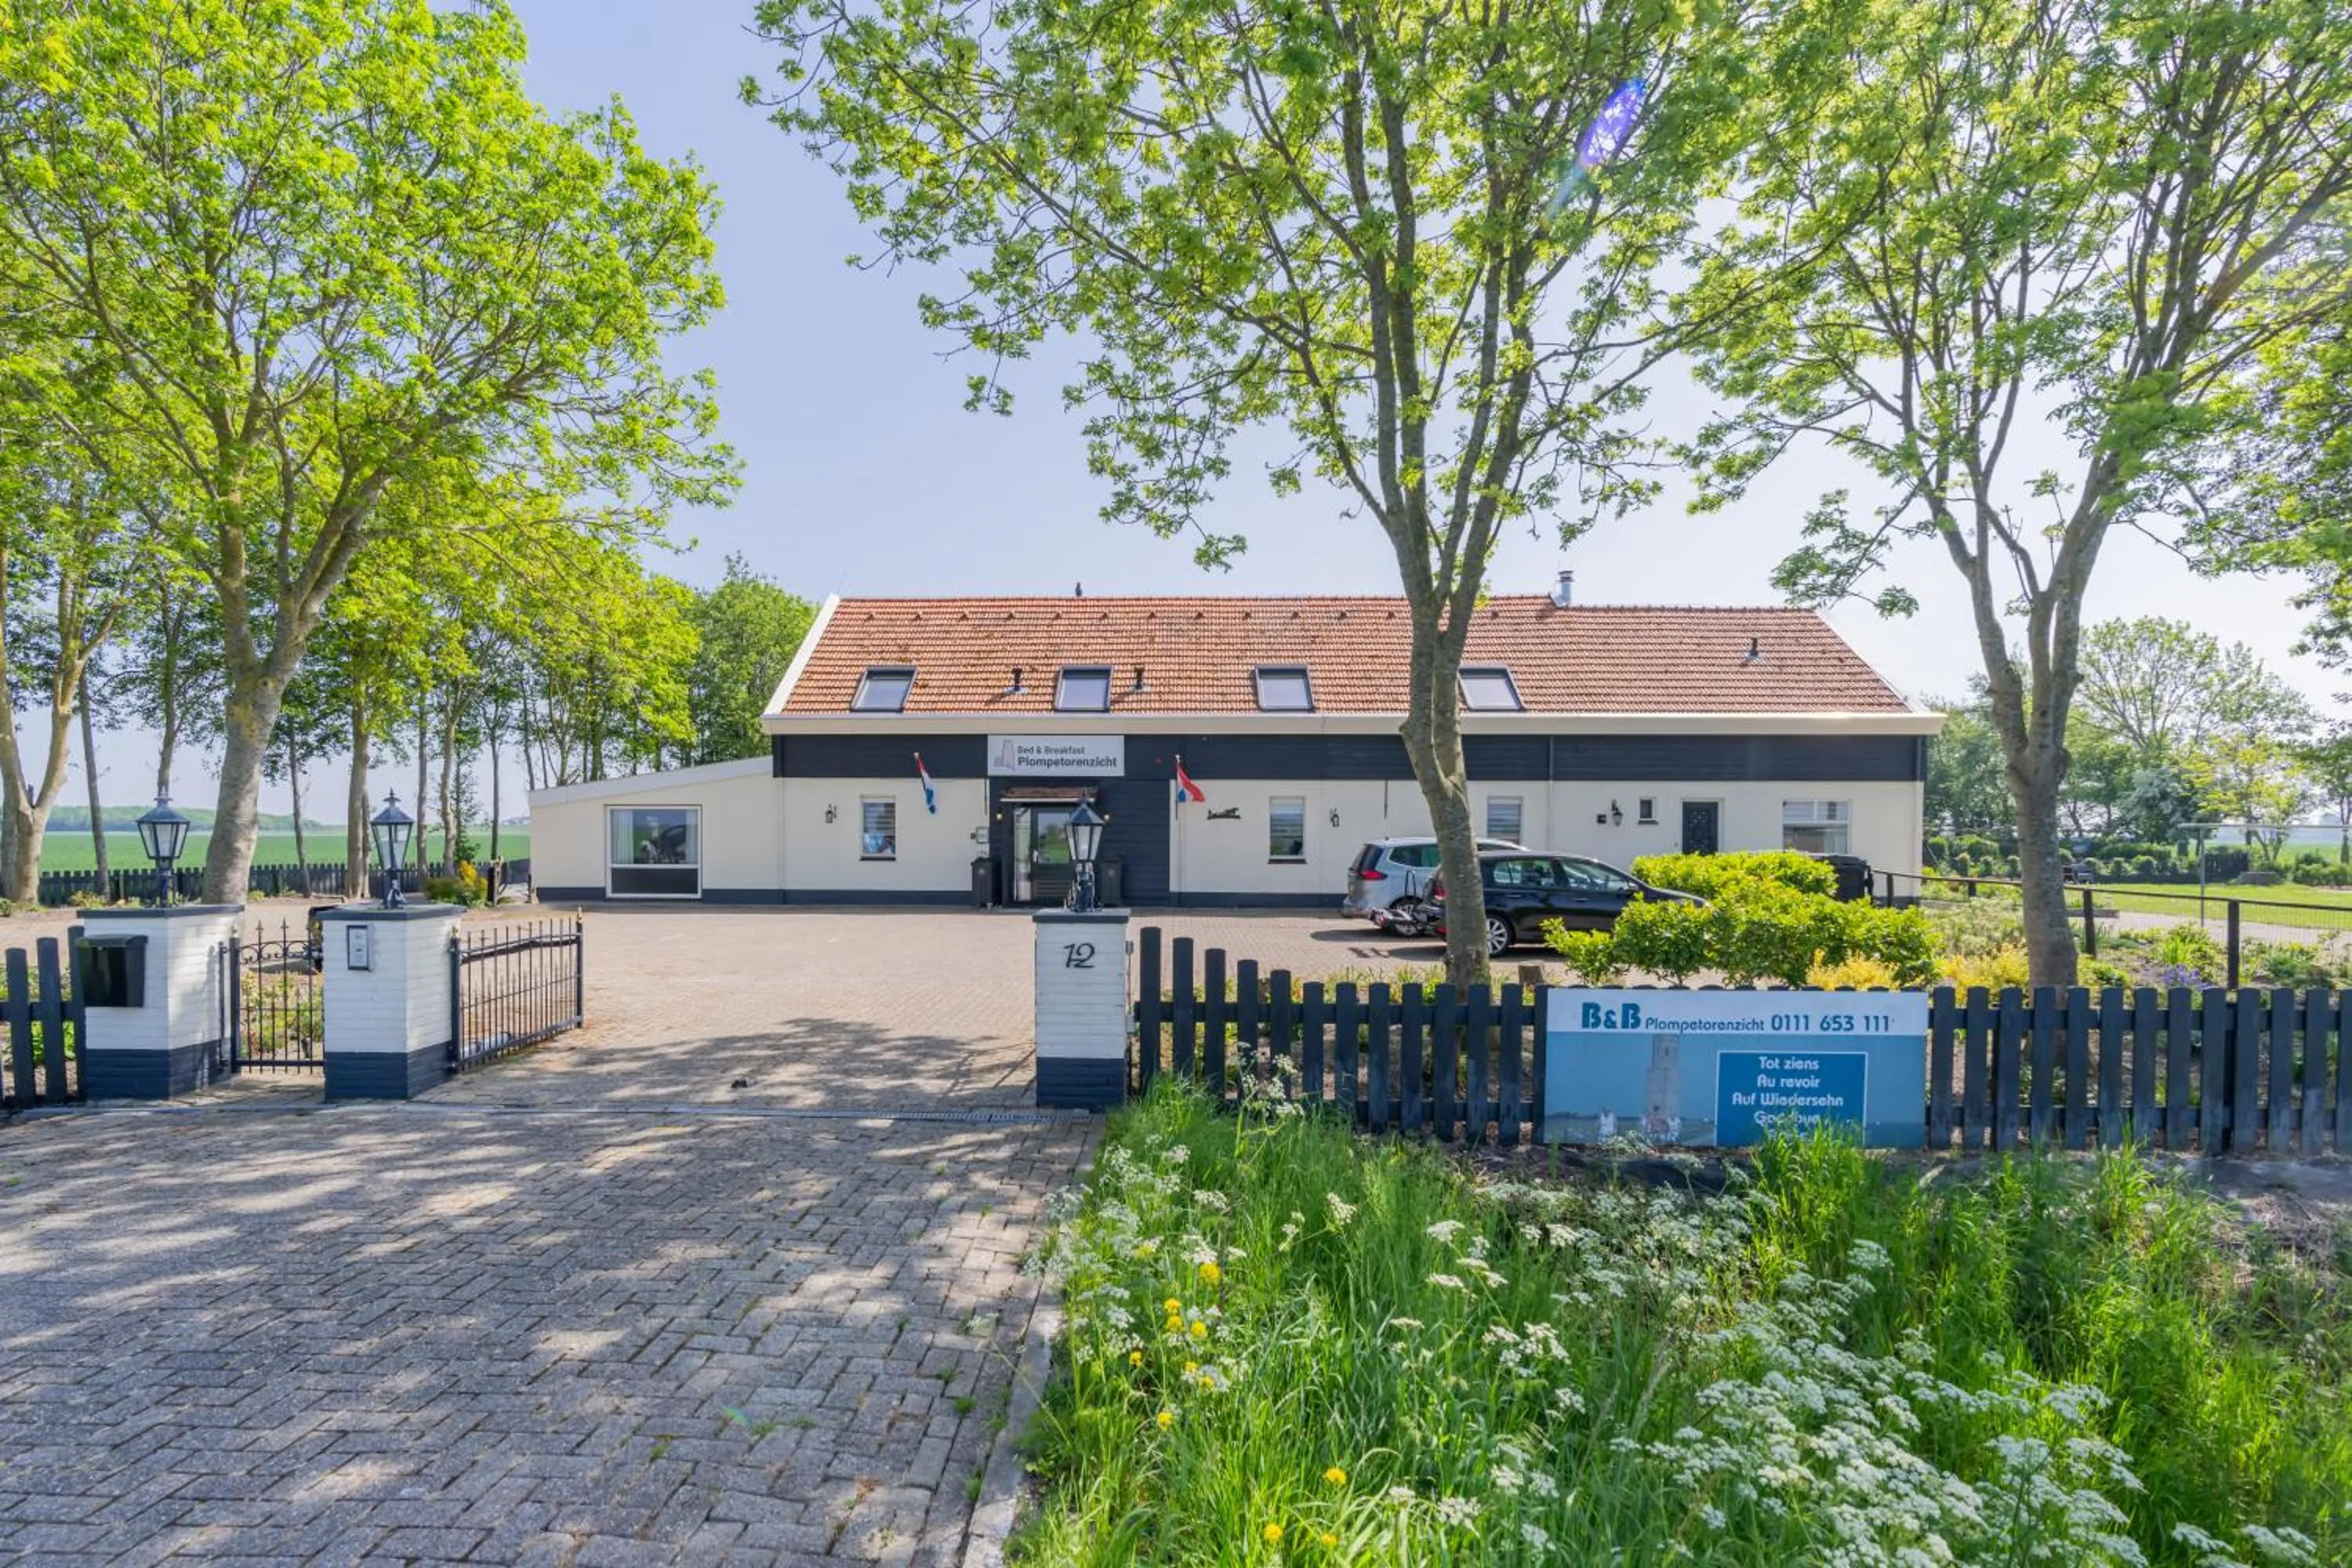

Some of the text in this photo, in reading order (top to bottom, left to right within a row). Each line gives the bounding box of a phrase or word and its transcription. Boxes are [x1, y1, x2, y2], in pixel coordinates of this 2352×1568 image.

[1018, 757, 1117, 768] Plompetorenzicht
[1063, 943, 1095, 968] 12
[1581, 1002, 1889, 1033] B&B Plompetorenzicht 0111 653 111
[1759, 1057, 1820, 1070] Tot ziens
[1758, 1075, 1821, 1087] Au revoir
[1732, 1092, 1844, 1107] Auf Wiedersehn
